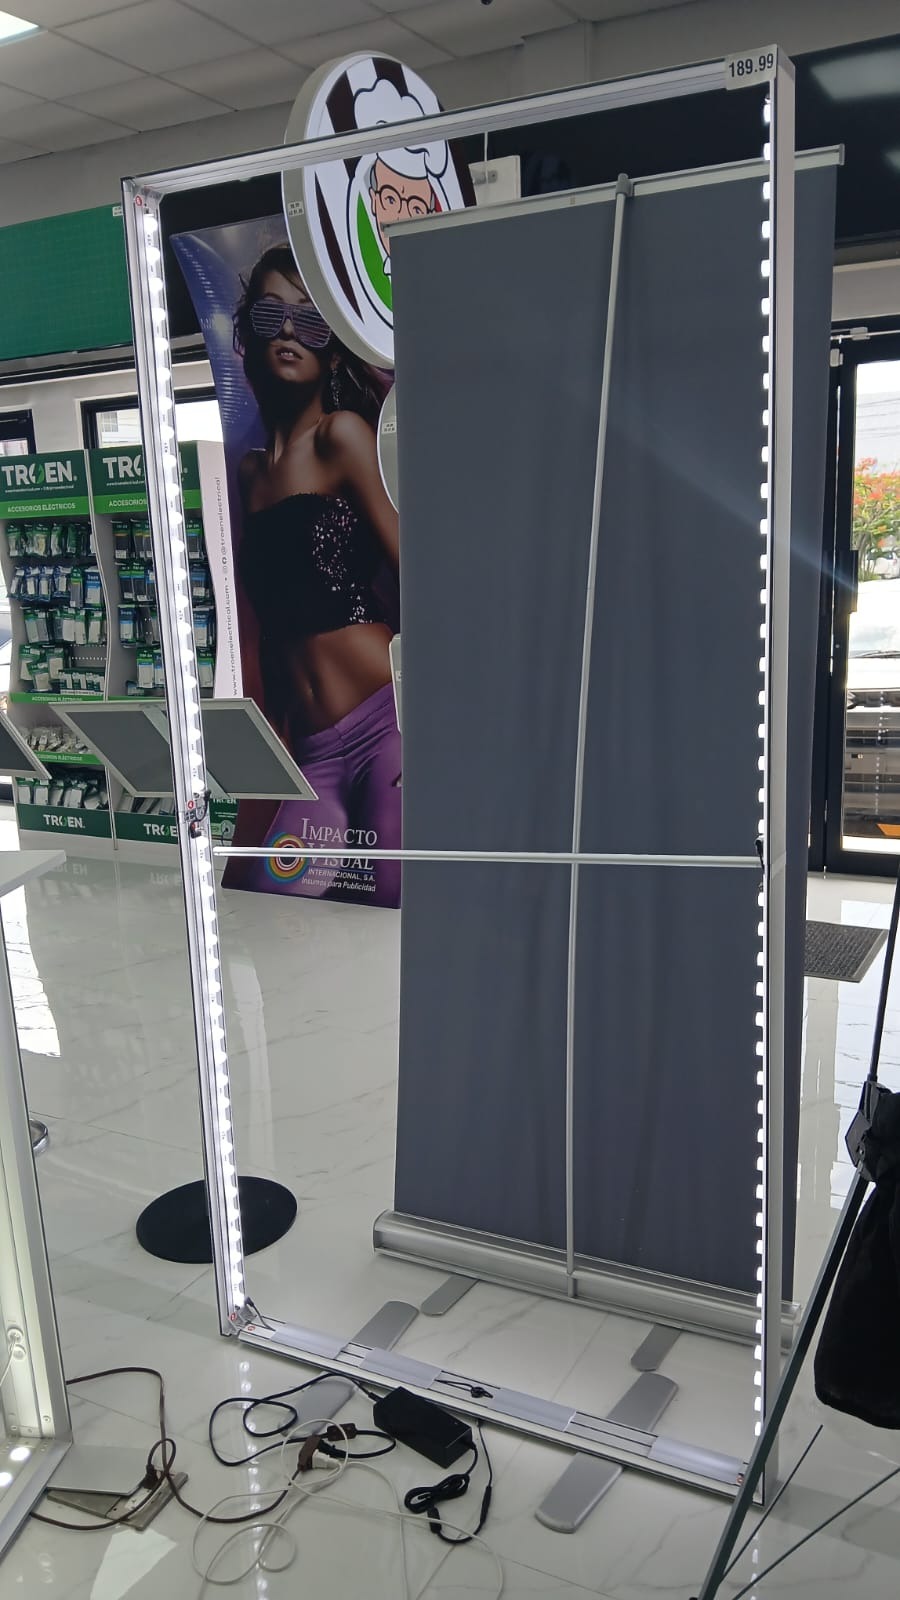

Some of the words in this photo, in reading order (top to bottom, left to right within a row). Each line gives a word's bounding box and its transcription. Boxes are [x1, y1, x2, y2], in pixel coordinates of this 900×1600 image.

[729, 53, 774, 77] 189.99
[143, 823, 178, 837] TROE
[300, 817, 378, 846] IMPACTO
[326, 881, 342, 889] para
[342, 881, 377, 892] Publicidad
